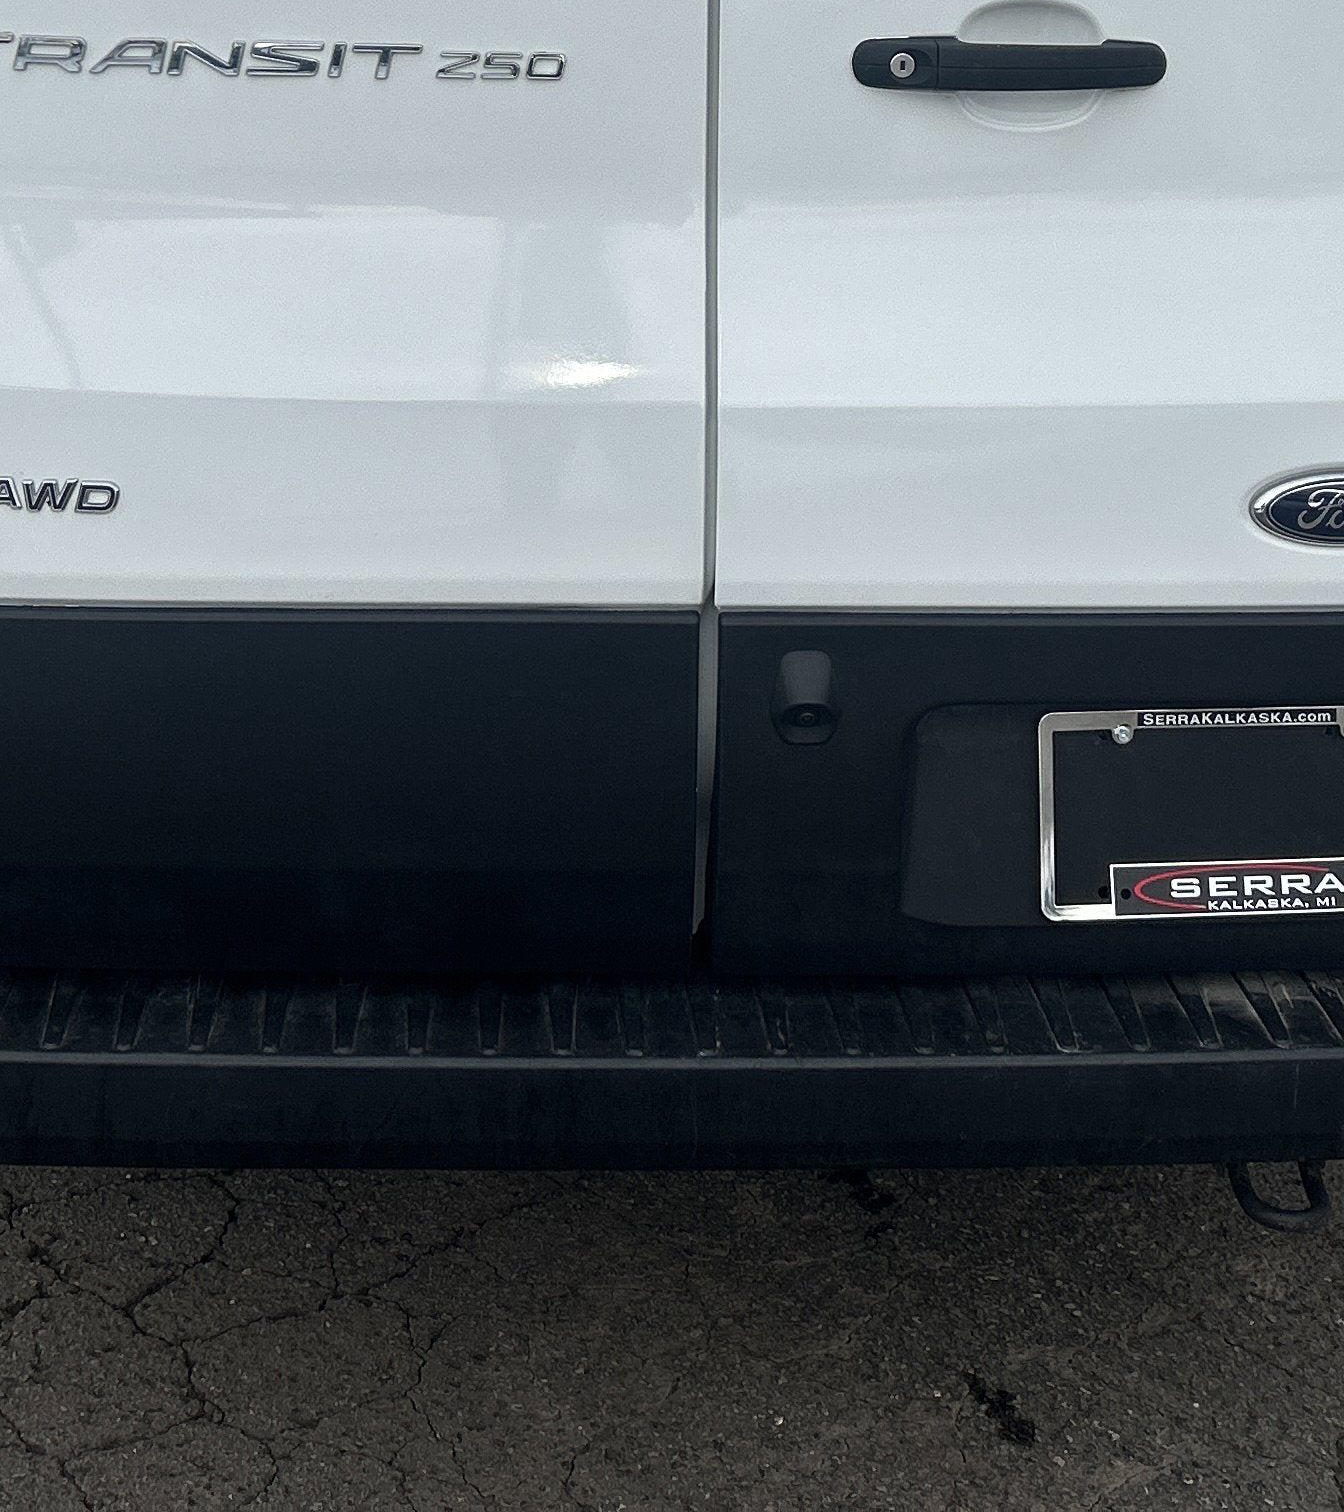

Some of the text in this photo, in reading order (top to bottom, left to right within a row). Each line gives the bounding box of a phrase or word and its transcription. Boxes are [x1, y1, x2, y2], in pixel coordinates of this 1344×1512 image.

[436, 50, 568, 81] 250
[1206, 896, 1338, 912] KALKASKA, MI
